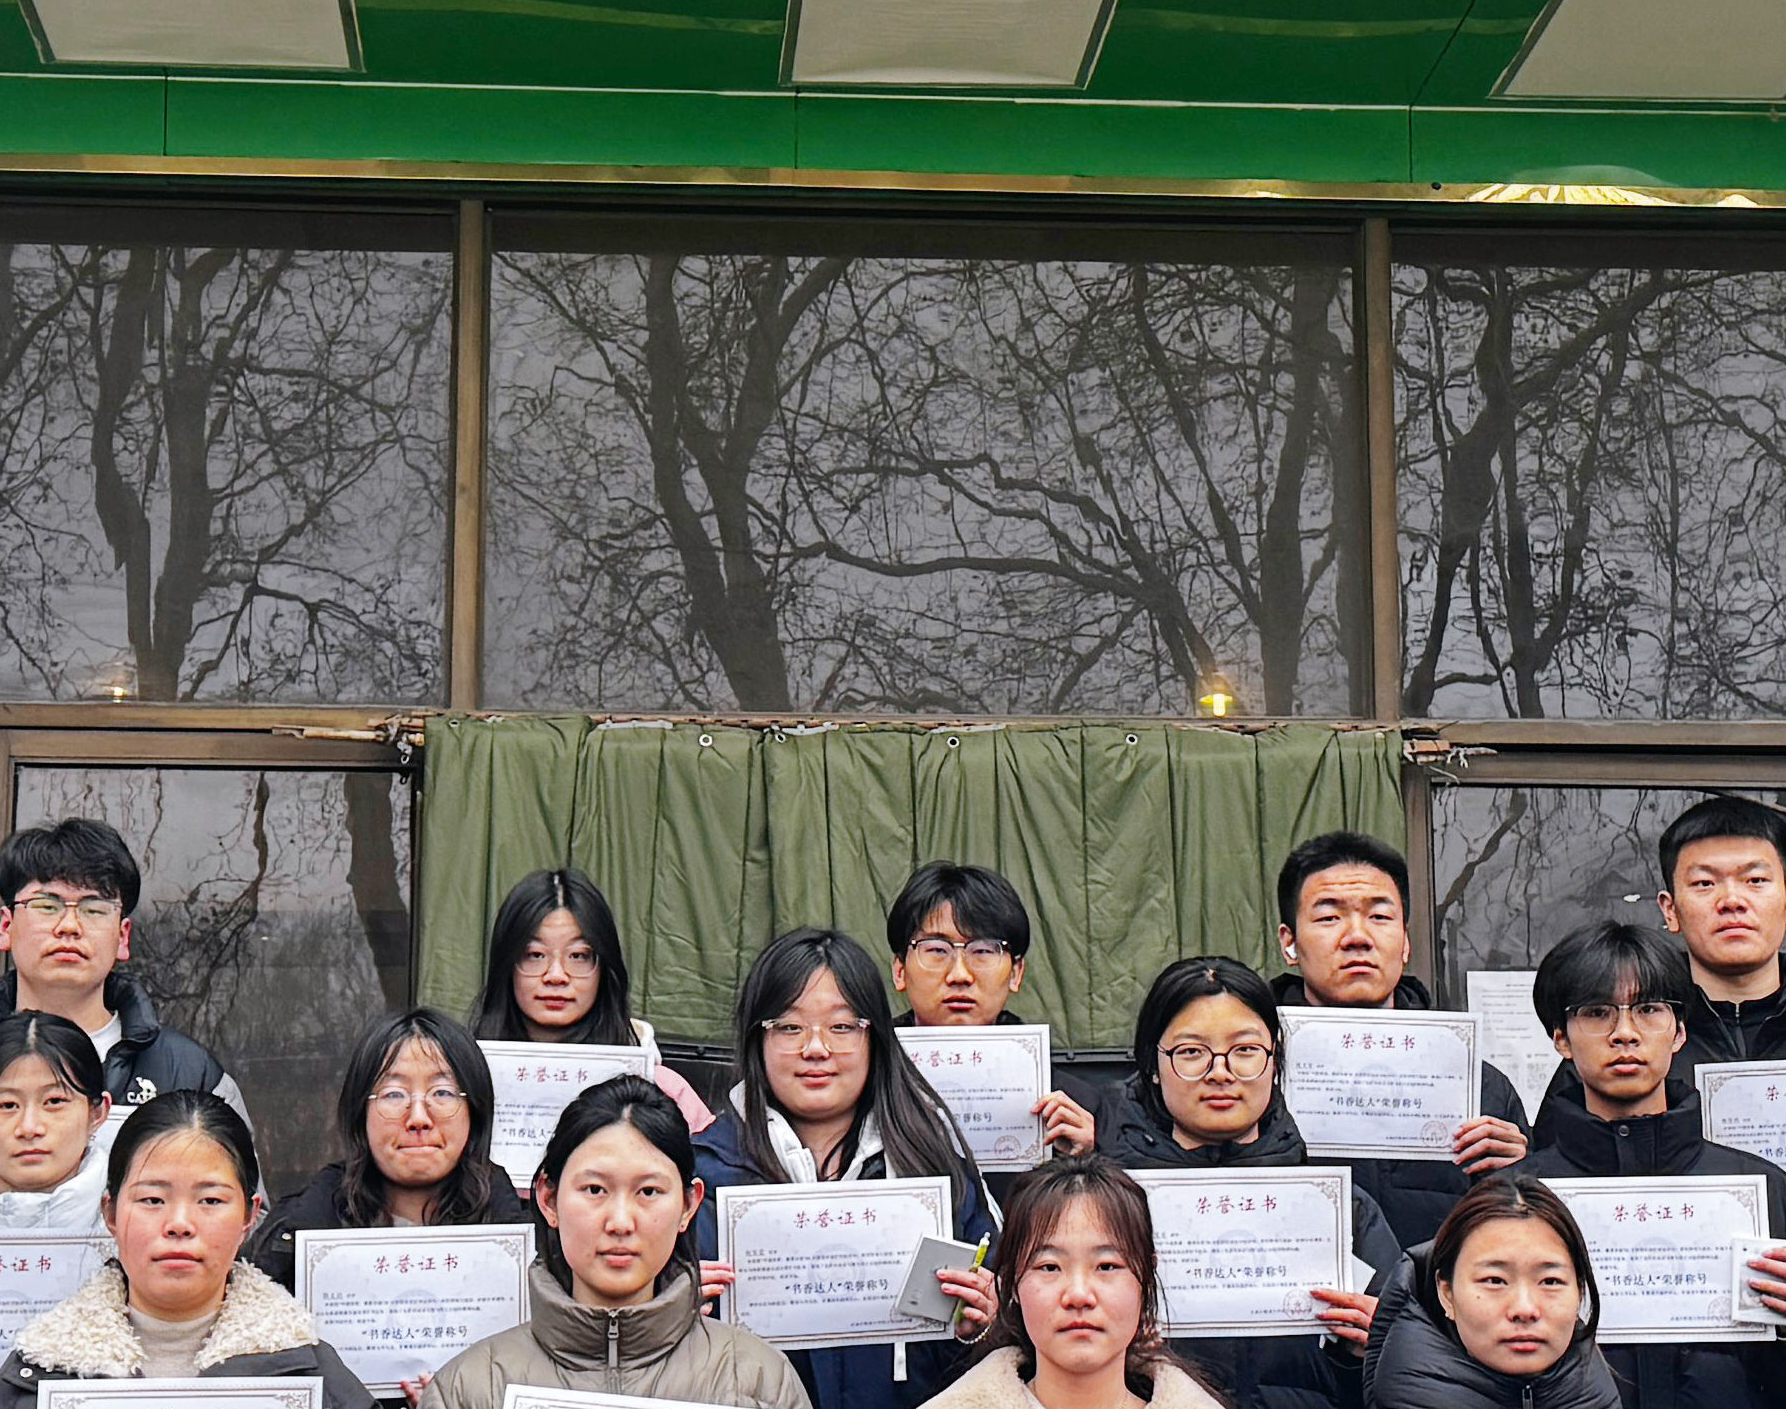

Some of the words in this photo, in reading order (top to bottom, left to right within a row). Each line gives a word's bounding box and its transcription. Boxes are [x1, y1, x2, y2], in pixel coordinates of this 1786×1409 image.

[1340, 1033, 1416, 1051] 荣誉证书
[1195, 1195, 1278, 1215] 荣誉证书
[1612, 1203, 1695, 1223] 荣誉证书
[793, 1207, 878, 1229] 荣誉证书
[373, 1253, 459, 1274] 荣誉证书
